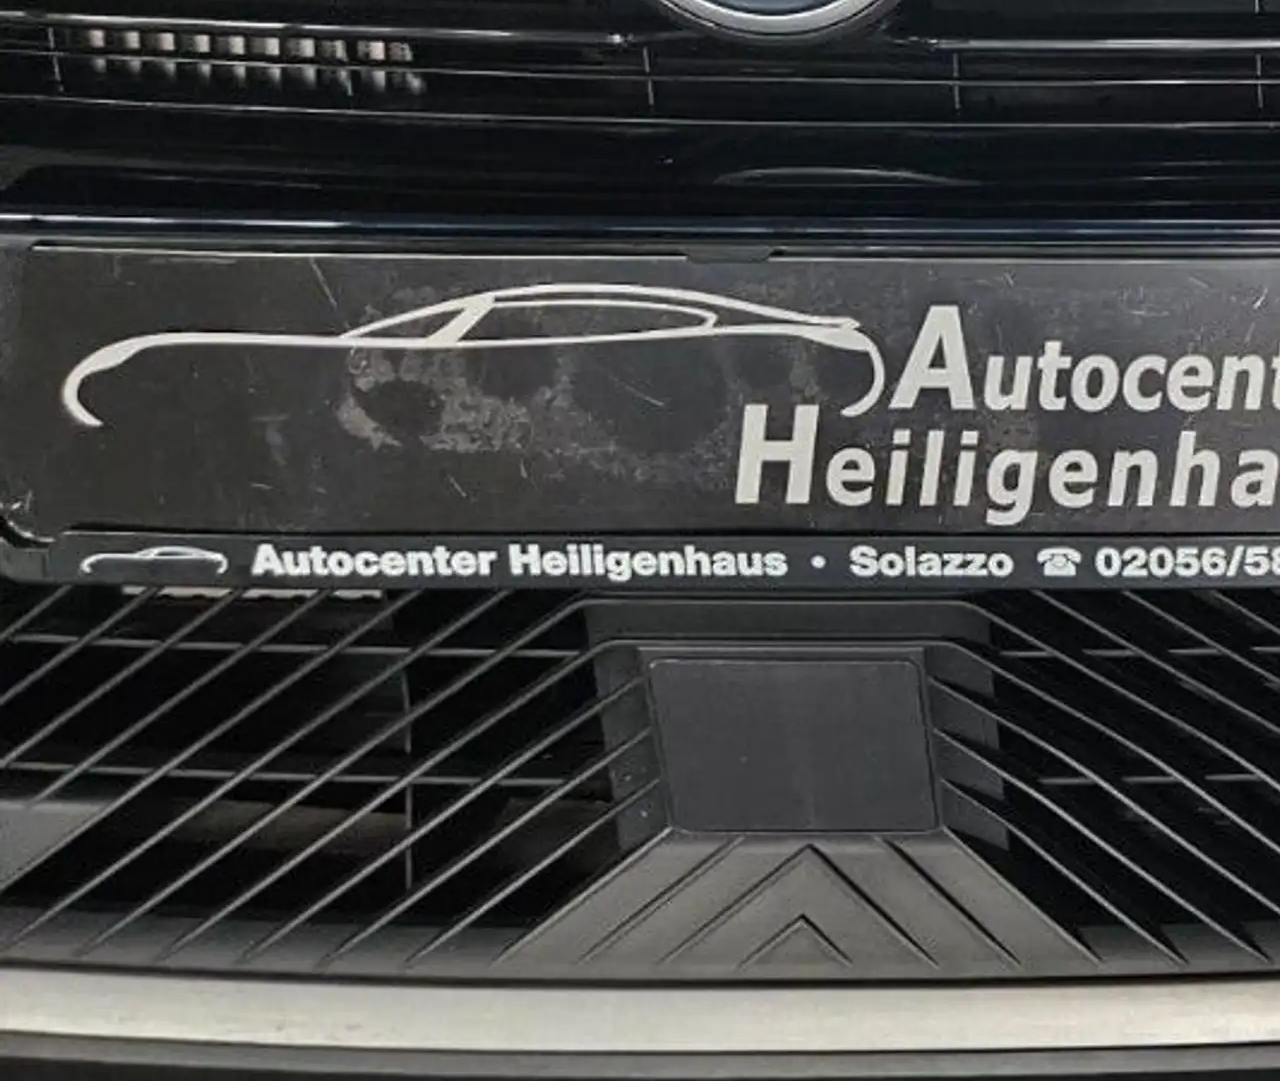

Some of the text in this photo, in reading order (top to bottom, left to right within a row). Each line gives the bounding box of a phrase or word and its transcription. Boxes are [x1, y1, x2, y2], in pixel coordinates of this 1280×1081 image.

[251, 542, 498, 578] Autocenter
[508, 542, 789, 582] Heiligenhaus
[849, 545, 1014, 578] Solazzo
